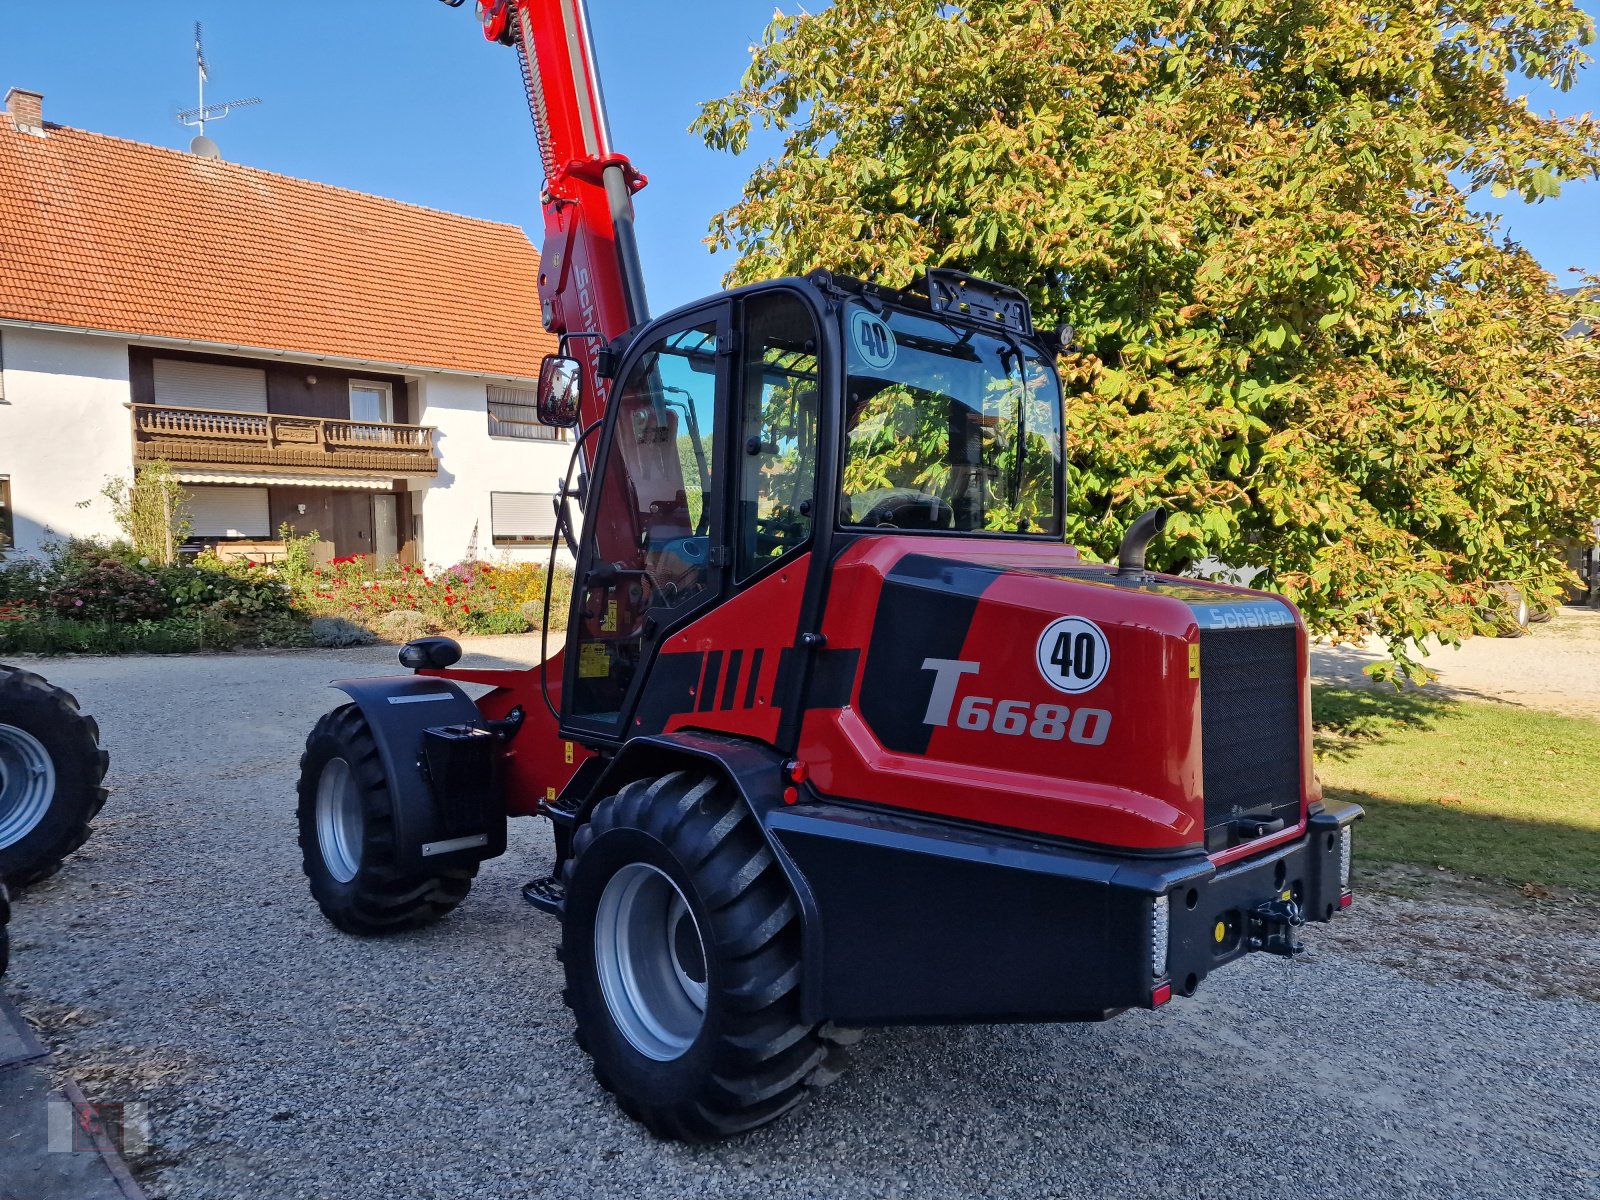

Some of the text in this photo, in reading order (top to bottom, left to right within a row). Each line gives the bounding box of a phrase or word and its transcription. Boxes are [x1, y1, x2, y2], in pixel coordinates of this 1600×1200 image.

[861, 320, 890, 359] 40
[1209, 607, 1287, 629] Schäffer
[1050, 632, 1096, 680] 40
